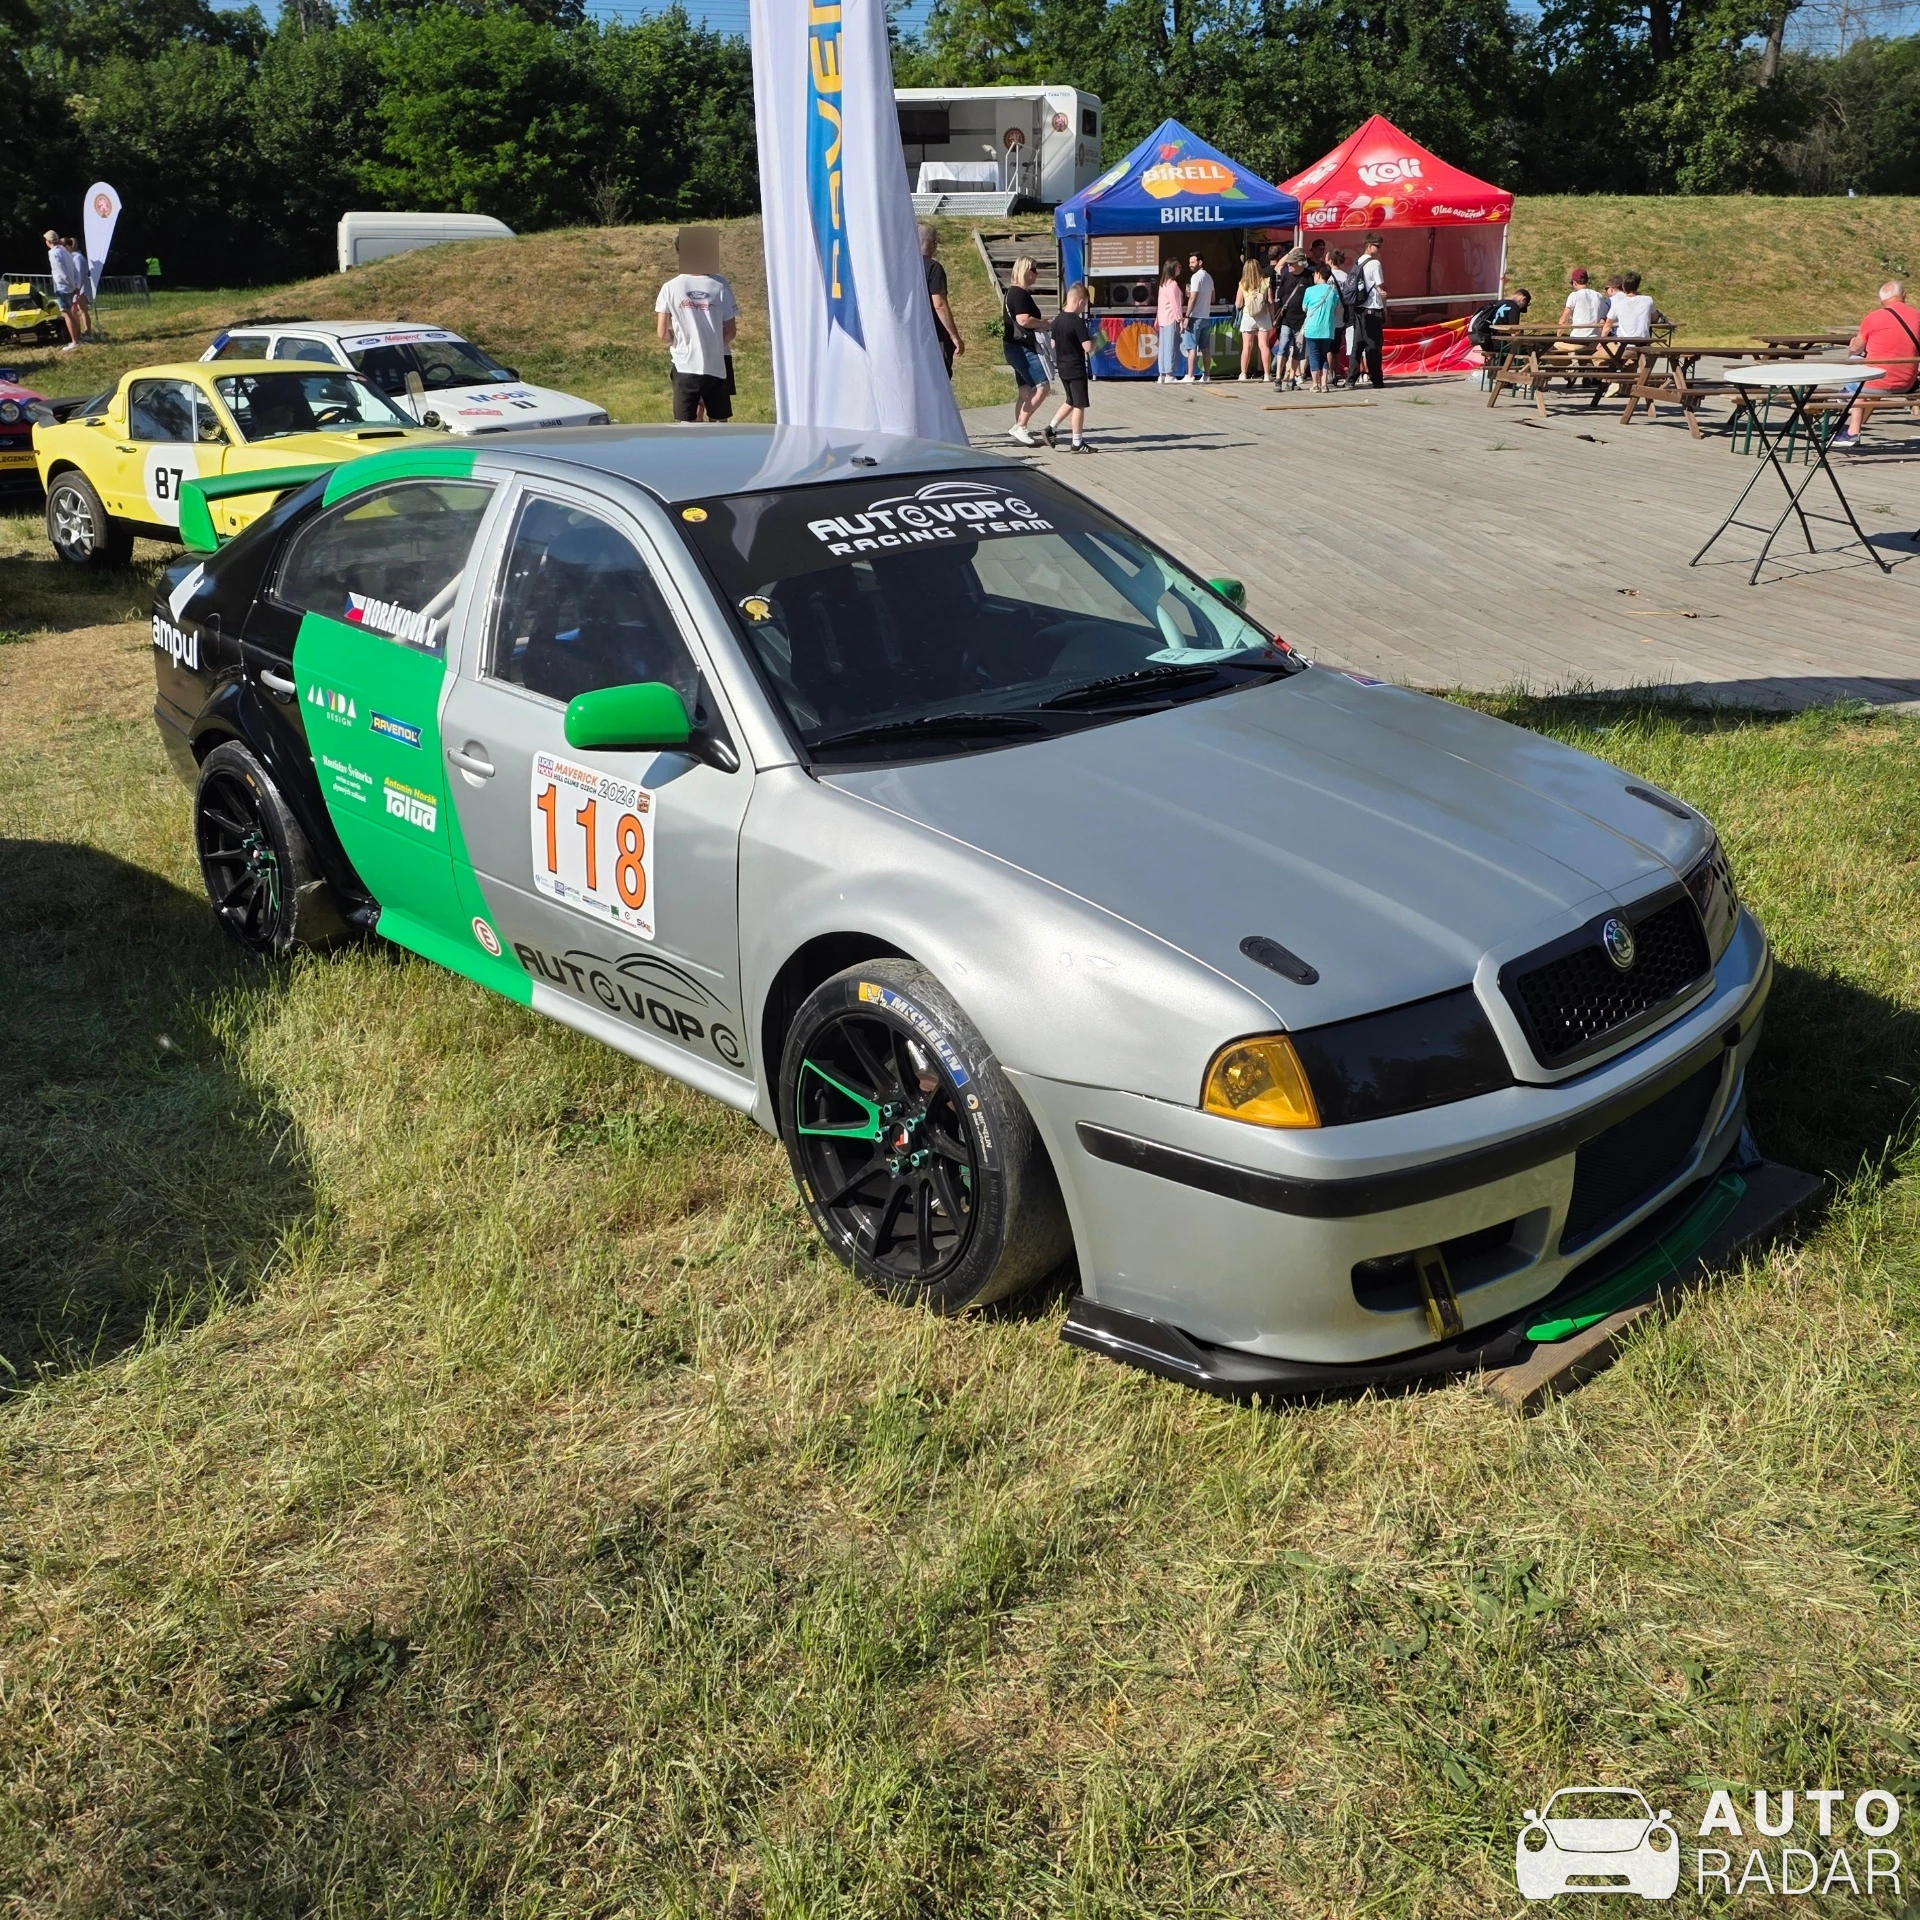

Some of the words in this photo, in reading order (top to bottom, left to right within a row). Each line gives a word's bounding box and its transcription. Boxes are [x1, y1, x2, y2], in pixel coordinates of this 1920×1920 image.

[1143, 165, 1225, 183] BIRELL
[1161, 206, 1224, 224] BIRELL
[466, 390, 536, 402] Mobil
[155, 466, 183, 500] 87
[828, 526, 957, 556] RACING
[968, 519, 1053, 534] TEAM
[152, 614, 198, 670] ampul
[326, 712, 352, 727] DESIGN
[373, 717, 417, 742] RAVENOL
[554, 763, 598, 786] MAVERICK
[414, 789, 437, 805] Horák
[554, 774, 563, 783] HILL
[598, 779, 637, 808] 2026
[537, 783, 647, 910] 118
[480, 926, 494, 947] E
[891, 997, 962, 1071] MICHELIN
[977, 1111, 992, 1148] MICHELIN
